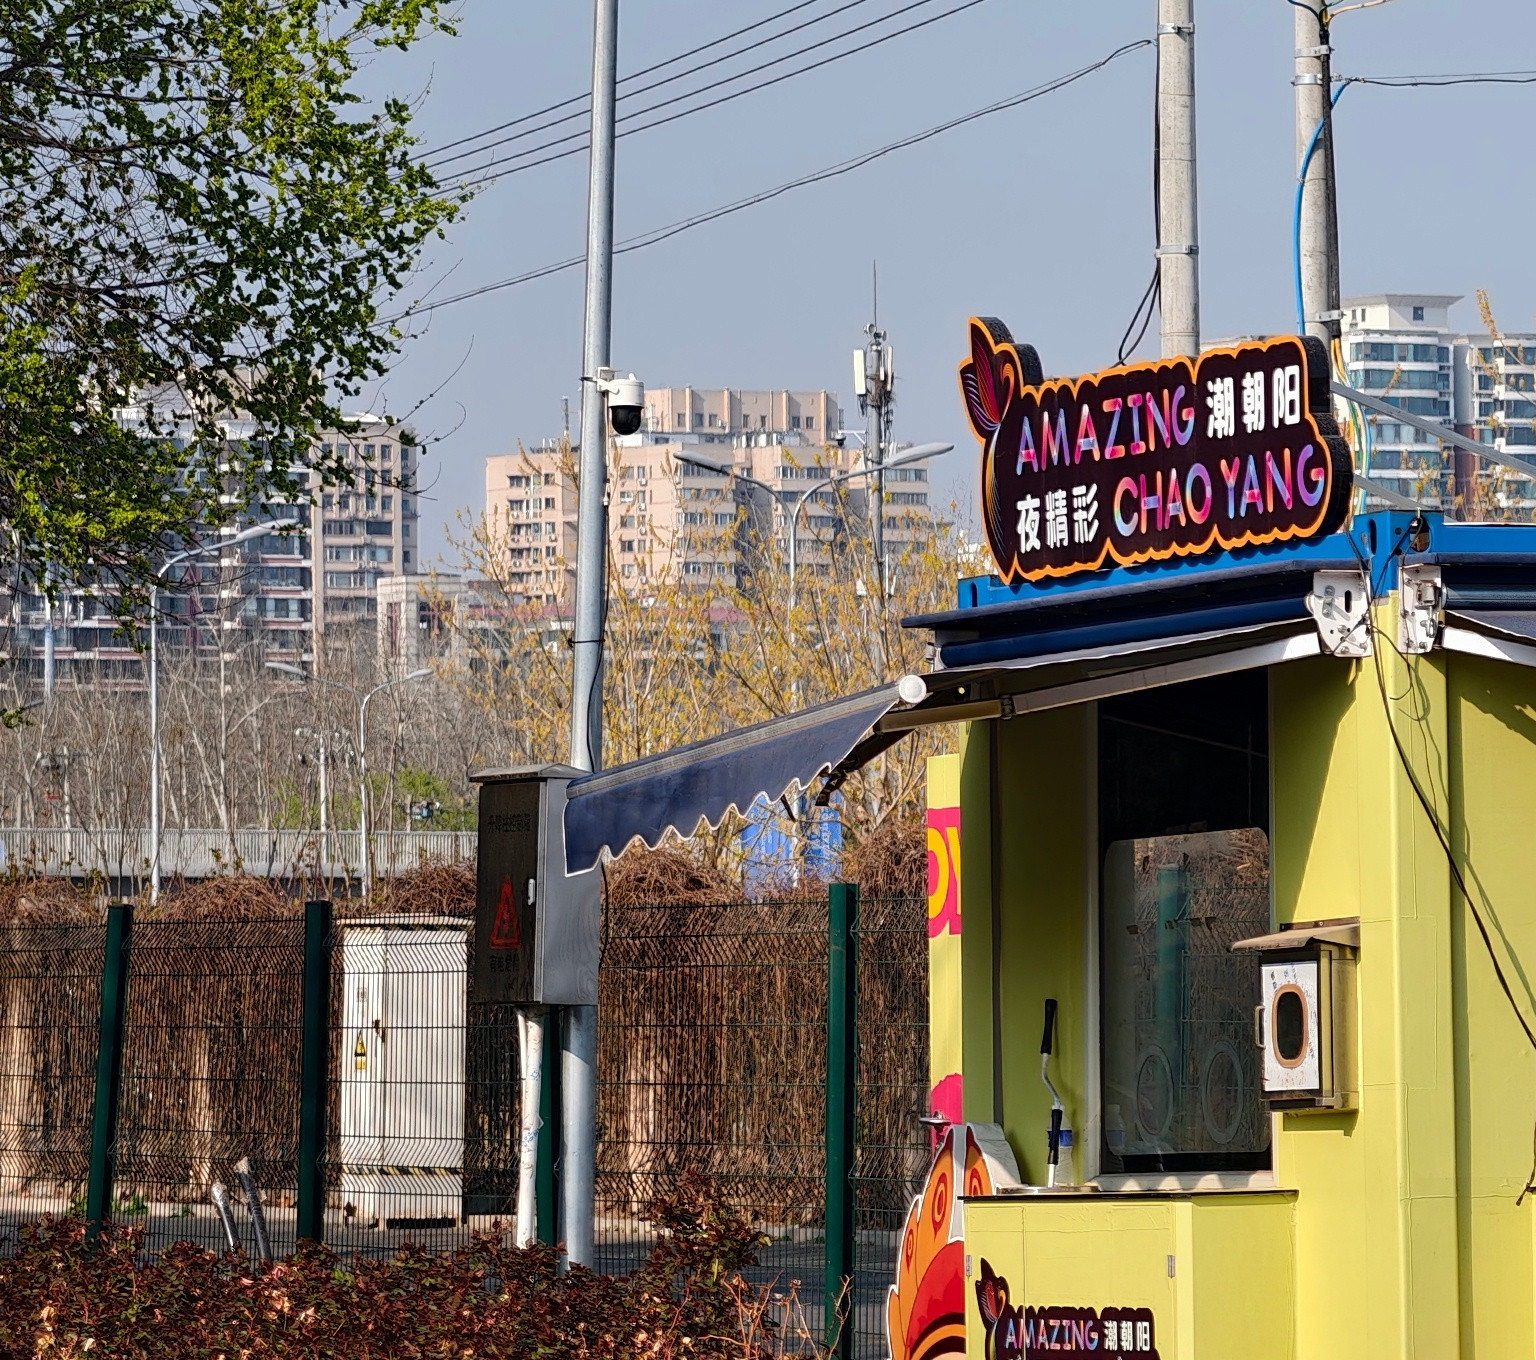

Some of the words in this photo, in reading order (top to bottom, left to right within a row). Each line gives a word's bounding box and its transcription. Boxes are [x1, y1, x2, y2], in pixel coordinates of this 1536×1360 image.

[1016, 385, 1195, 475] AMAZING
[1206, 364, 1301, 439] 潮朝阳
[1016, 482, 1099, 554] 夜精彩
[1114, 462, 1213, 536] CHAO
[1220, 444, 1325, 519] YANG
[1004, 1318, 1099, 1350] AMAZING
[1103, 1320, 1151, 1351] 潮朝阳
